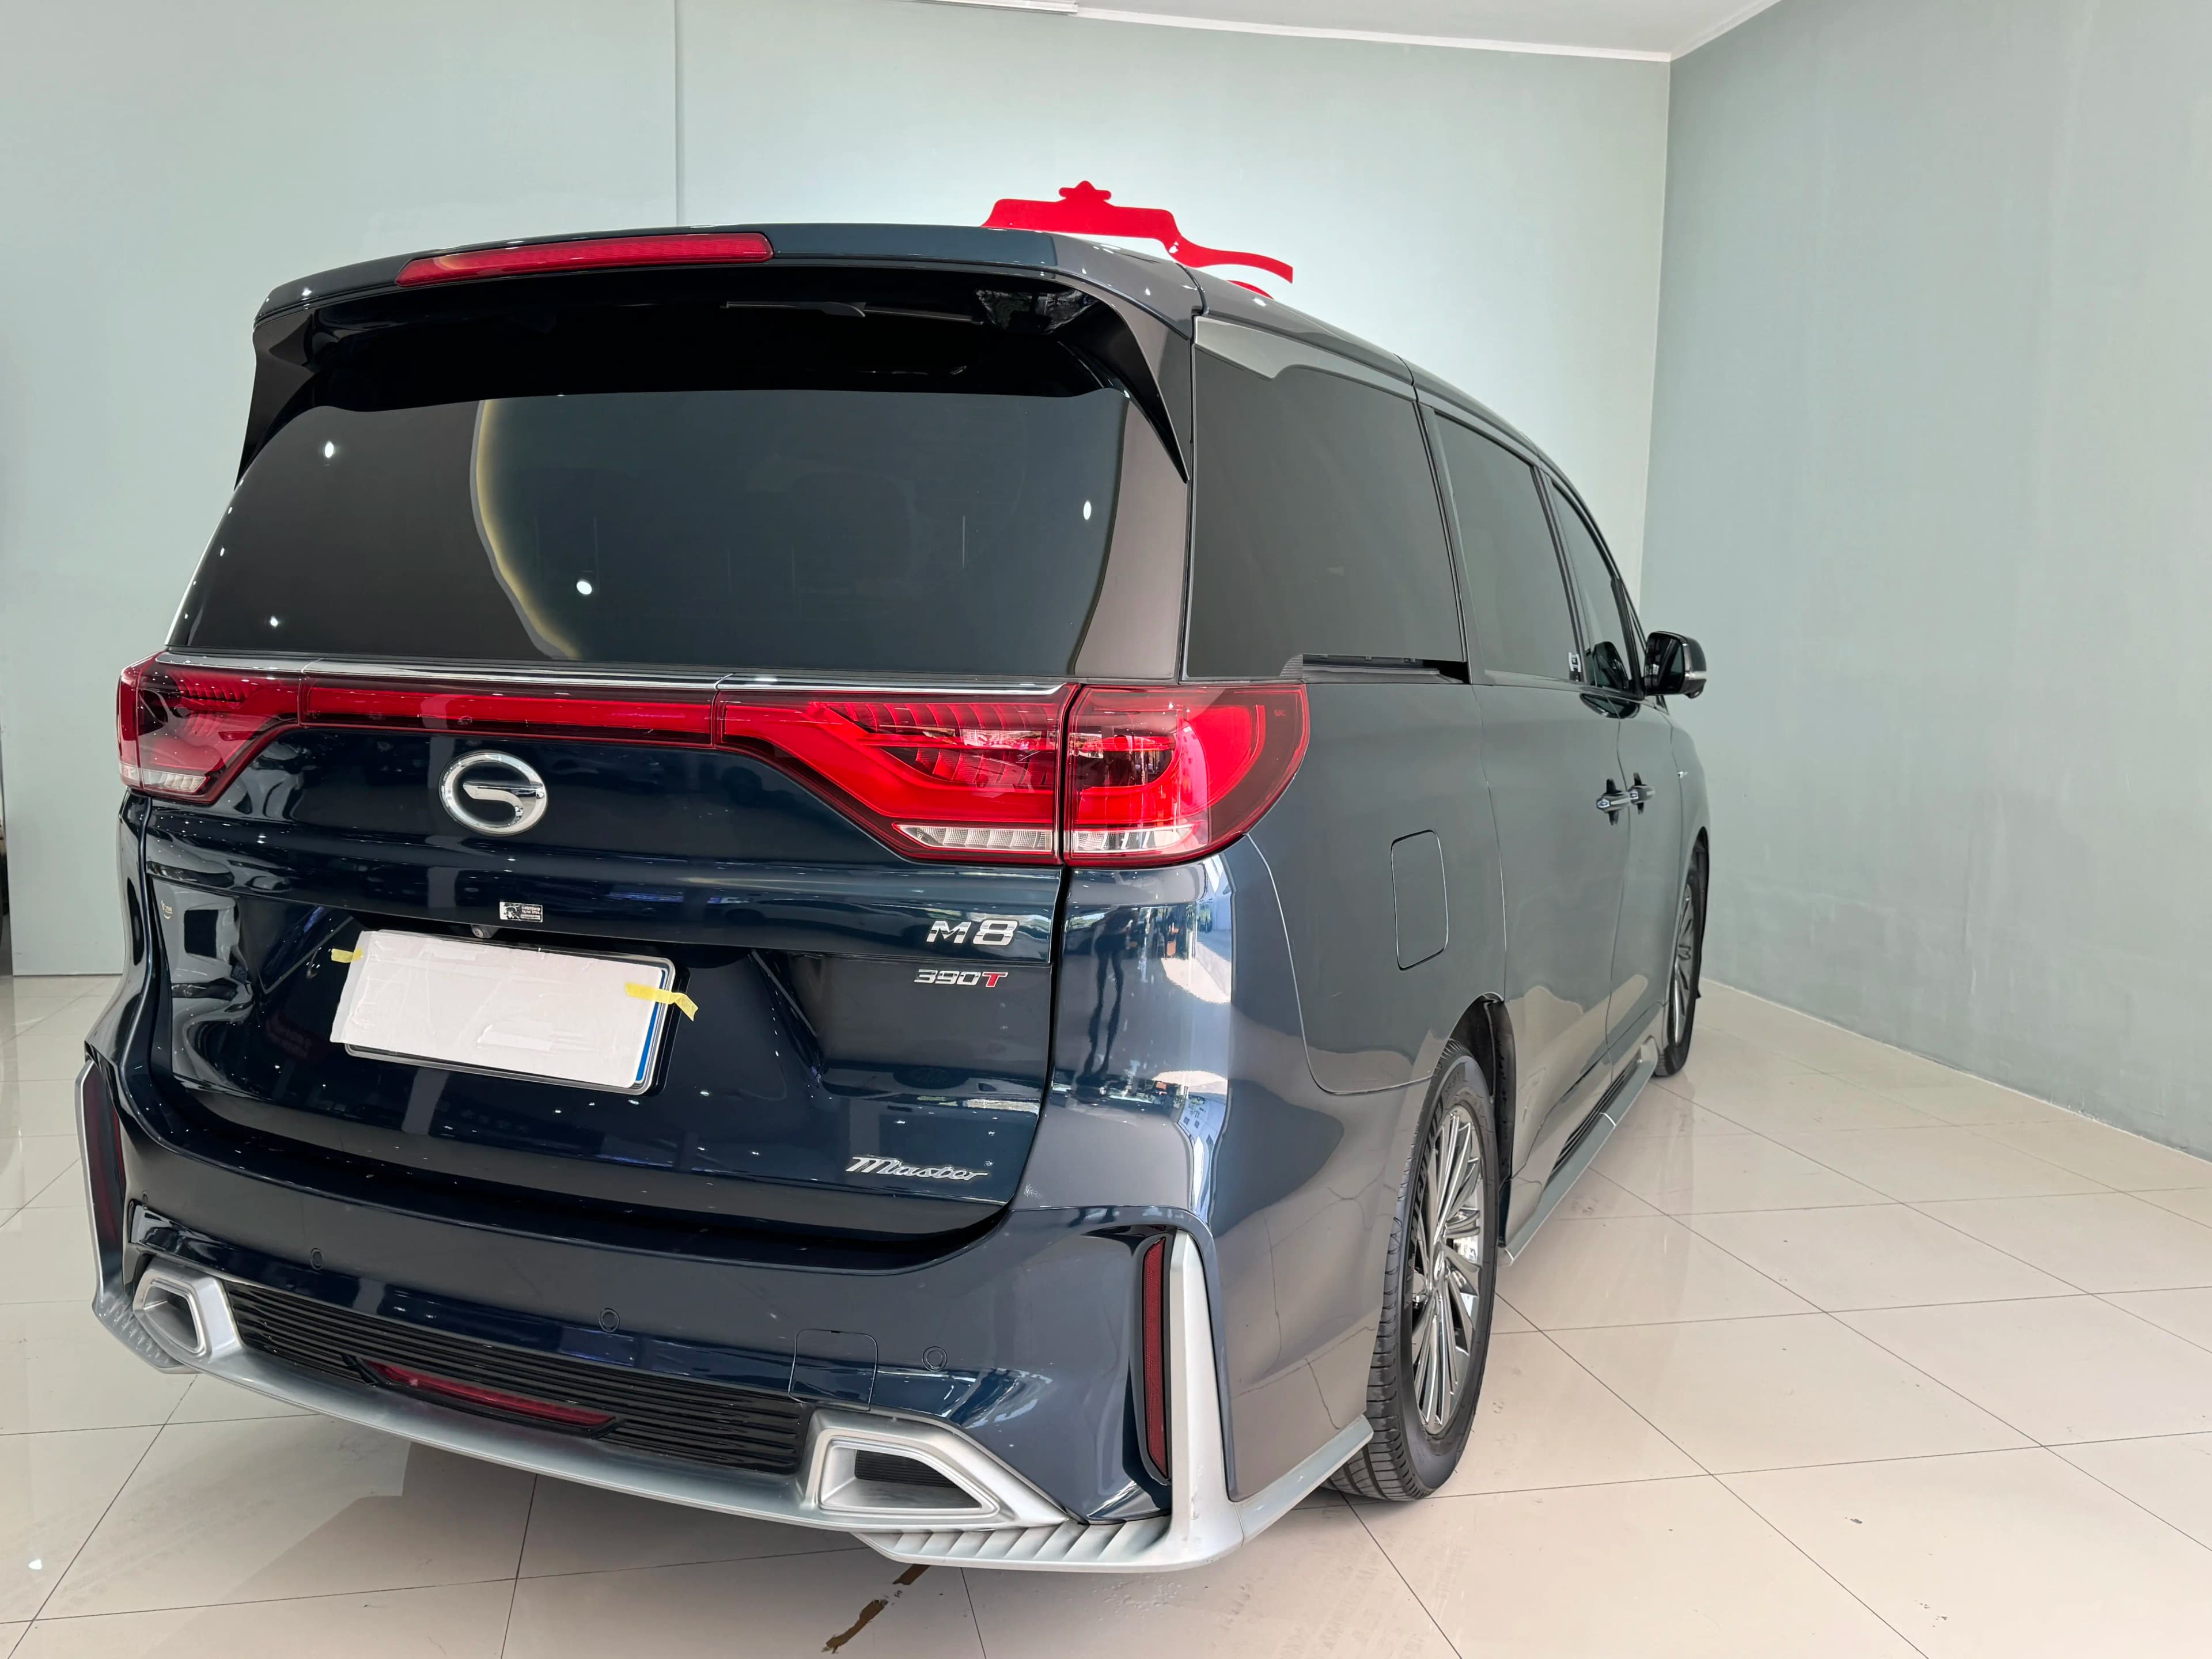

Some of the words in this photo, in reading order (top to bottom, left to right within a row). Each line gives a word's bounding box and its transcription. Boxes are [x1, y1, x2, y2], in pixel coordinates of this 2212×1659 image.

[926, 920, 1020, 946] M8
[914, 969, 1009, 988] 390T
[845, 1155, 988, 1181] Master
